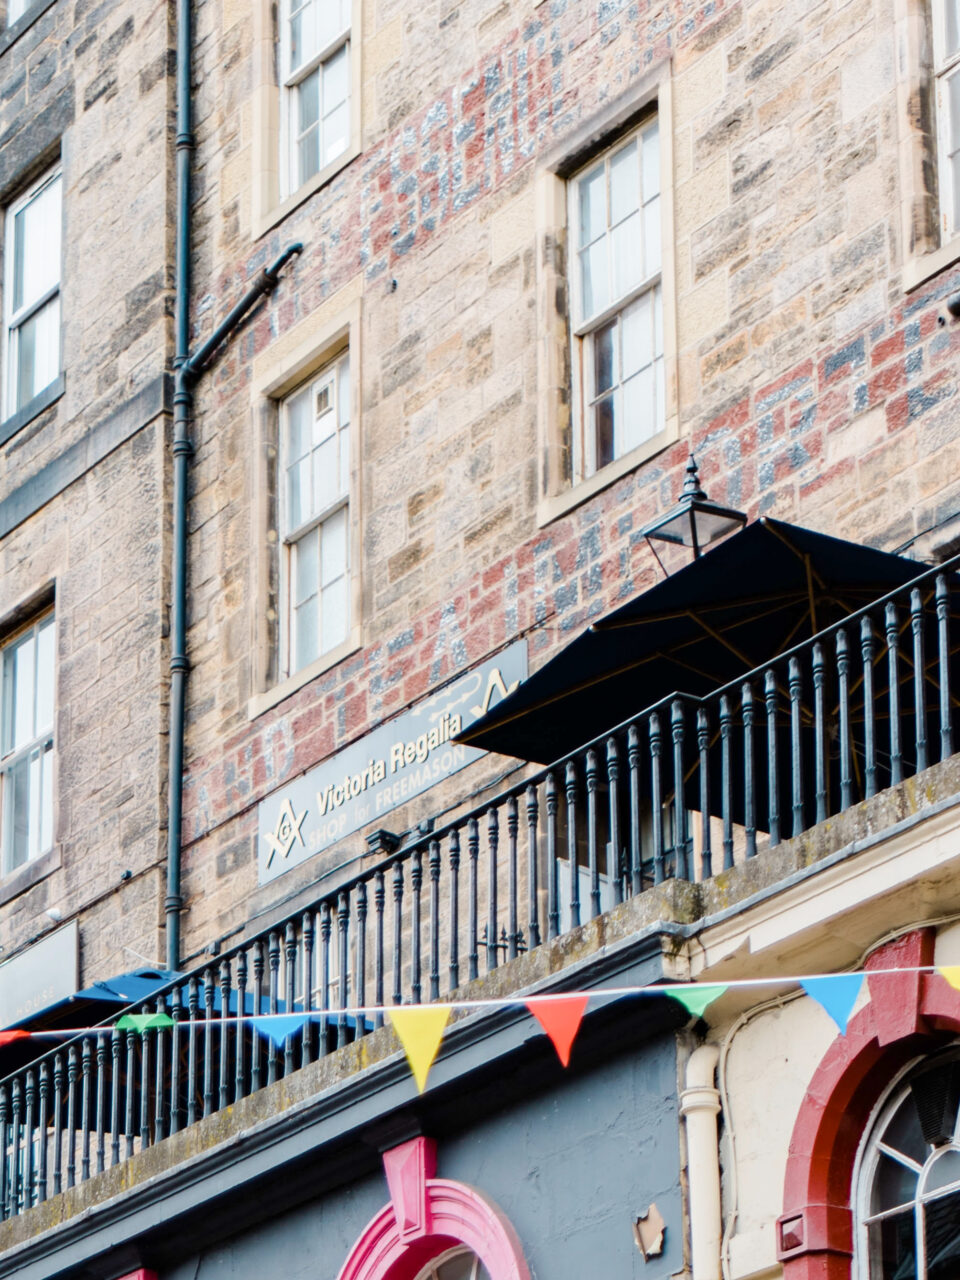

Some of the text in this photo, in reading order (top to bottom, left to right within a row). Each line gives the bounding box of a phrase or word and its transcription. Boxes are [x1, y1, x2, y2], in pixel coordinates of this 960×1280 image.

[316, 713, 462, 816] Victoria Regalia
[308, 812, 346, 849] SHOP
